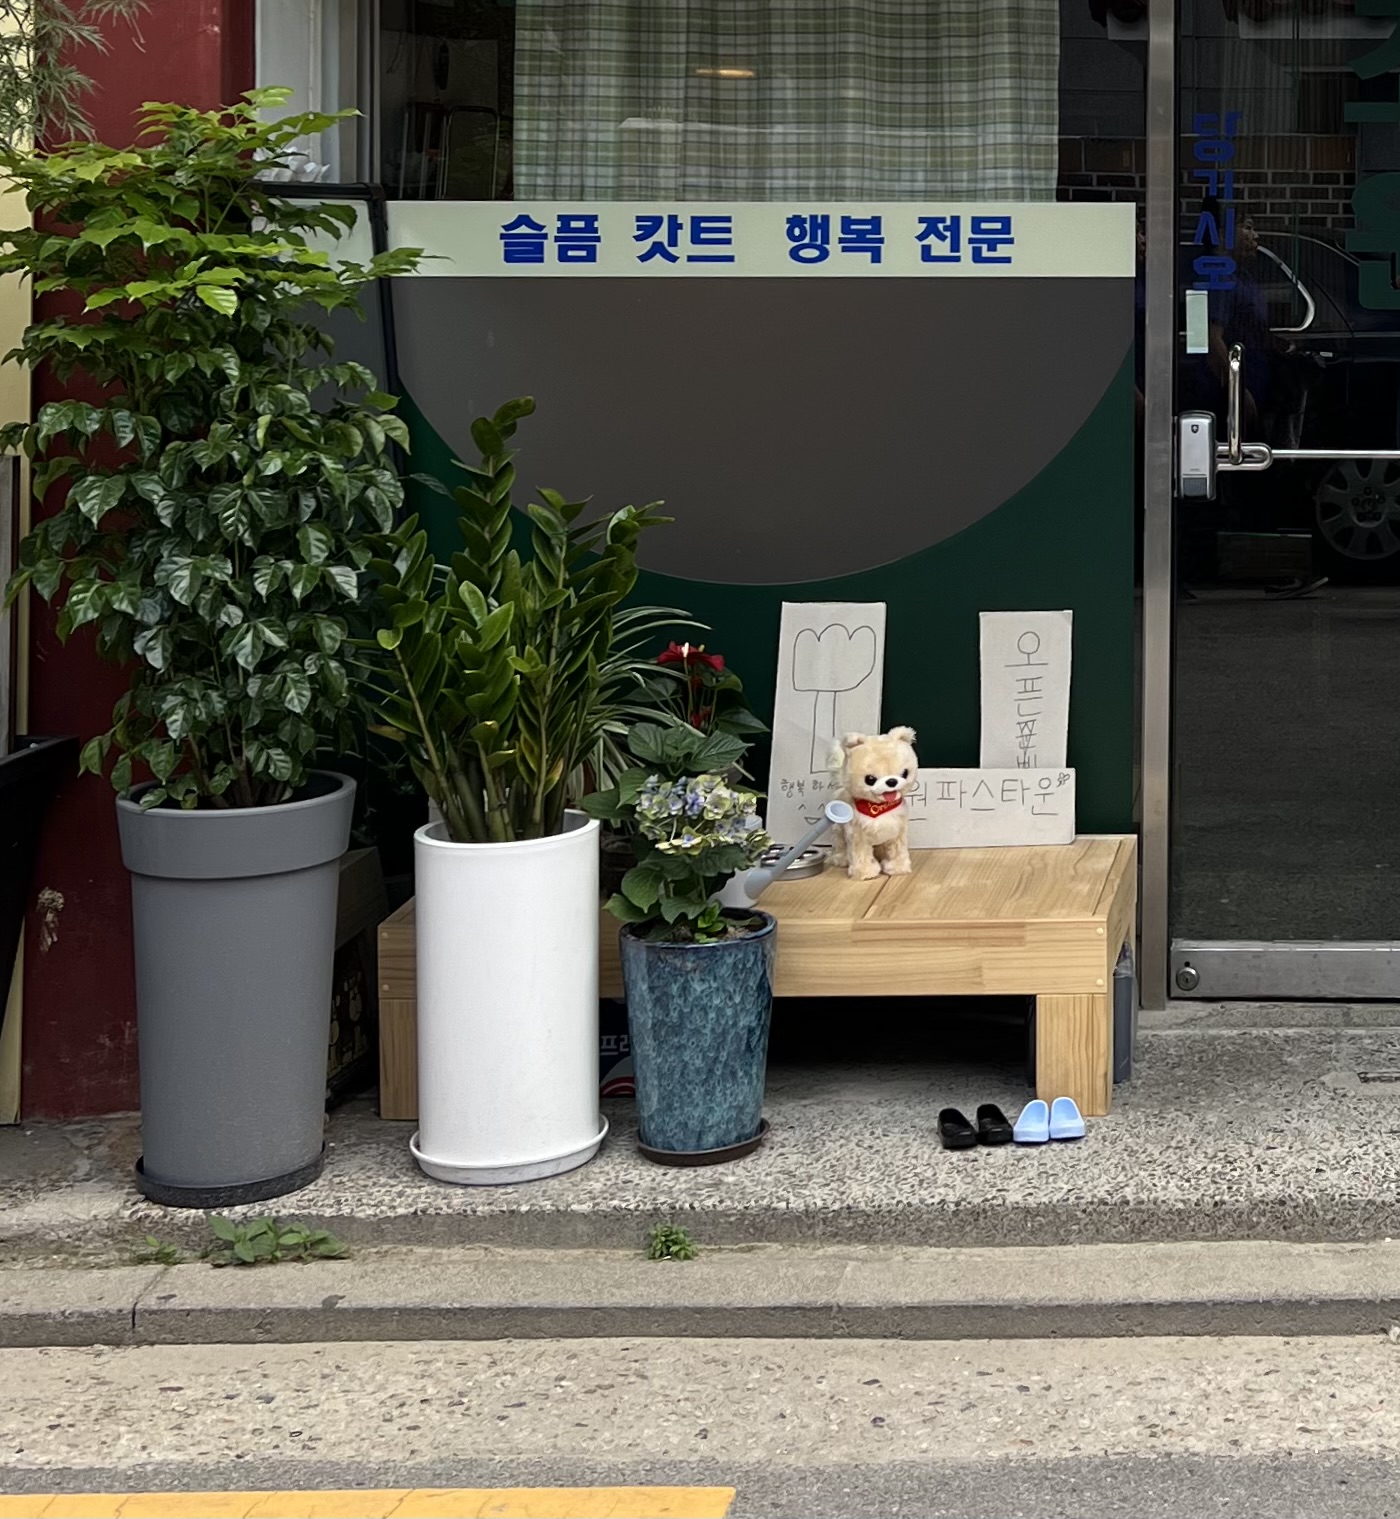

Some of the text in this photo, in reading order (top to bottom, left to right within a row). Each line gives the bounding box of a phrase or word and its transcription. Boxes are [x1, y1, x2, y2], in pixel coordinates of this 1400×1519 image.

[500, 213, 1015, 264] 슬픔 캇트 행복 전문
[1191, 110, 1242, 291] 당기시오
